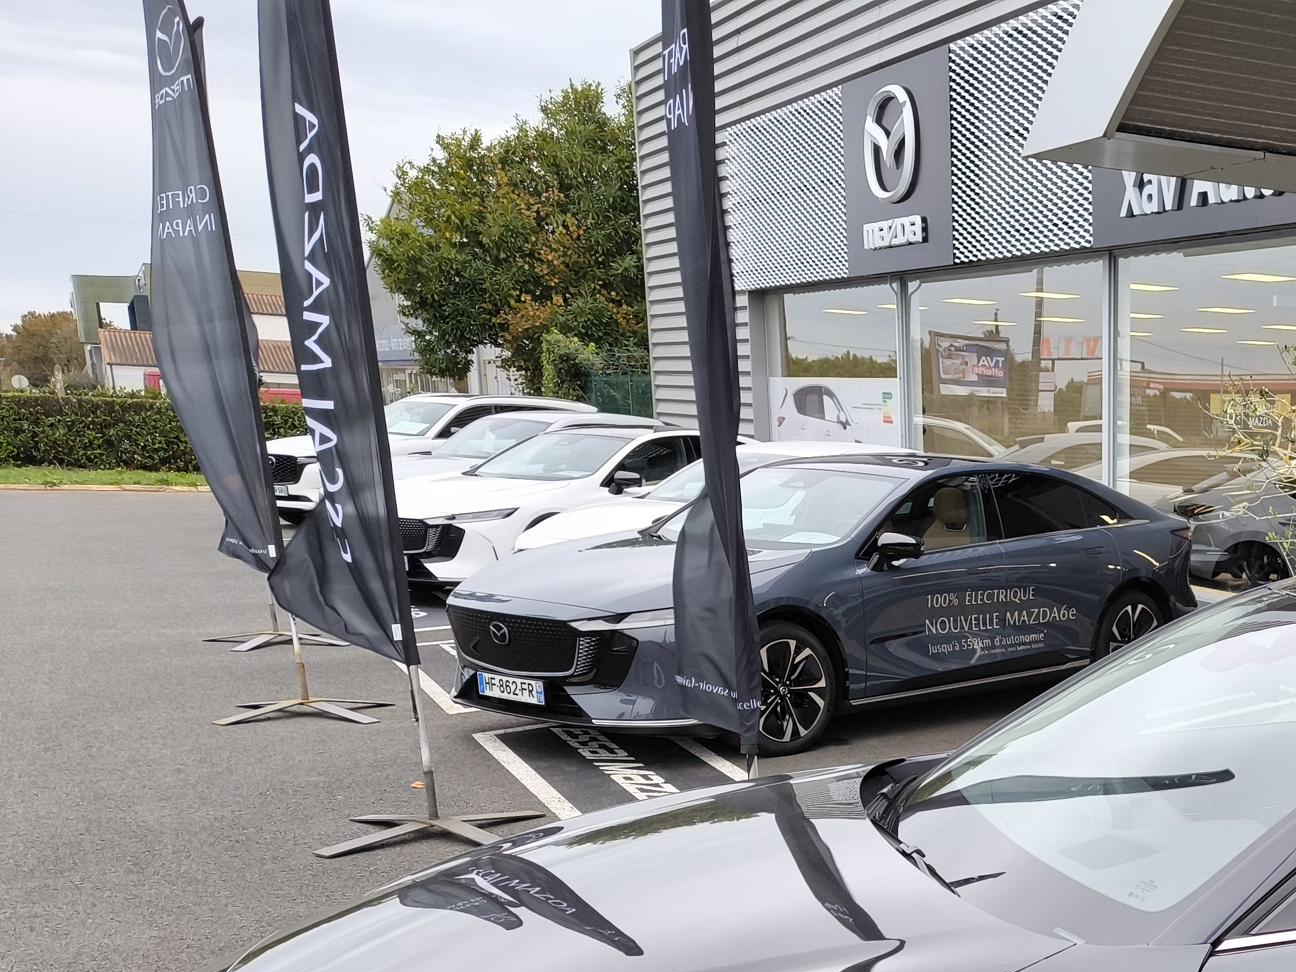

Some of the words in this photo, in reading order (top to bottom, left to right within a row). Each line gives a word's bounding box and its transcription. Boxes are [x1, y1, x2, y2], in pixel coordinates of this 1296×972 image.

[863, 214, 923, 249] mazda
[926, 592, 959, 609] 100%
[965, 586, 1036, 606] ÉLECTRIQUE
[925, 612, 1000, 636] NOUVELLE
[1005, 604, 1077, 627] MAZDA6e
[592, 761, 682, 801] MaZ
